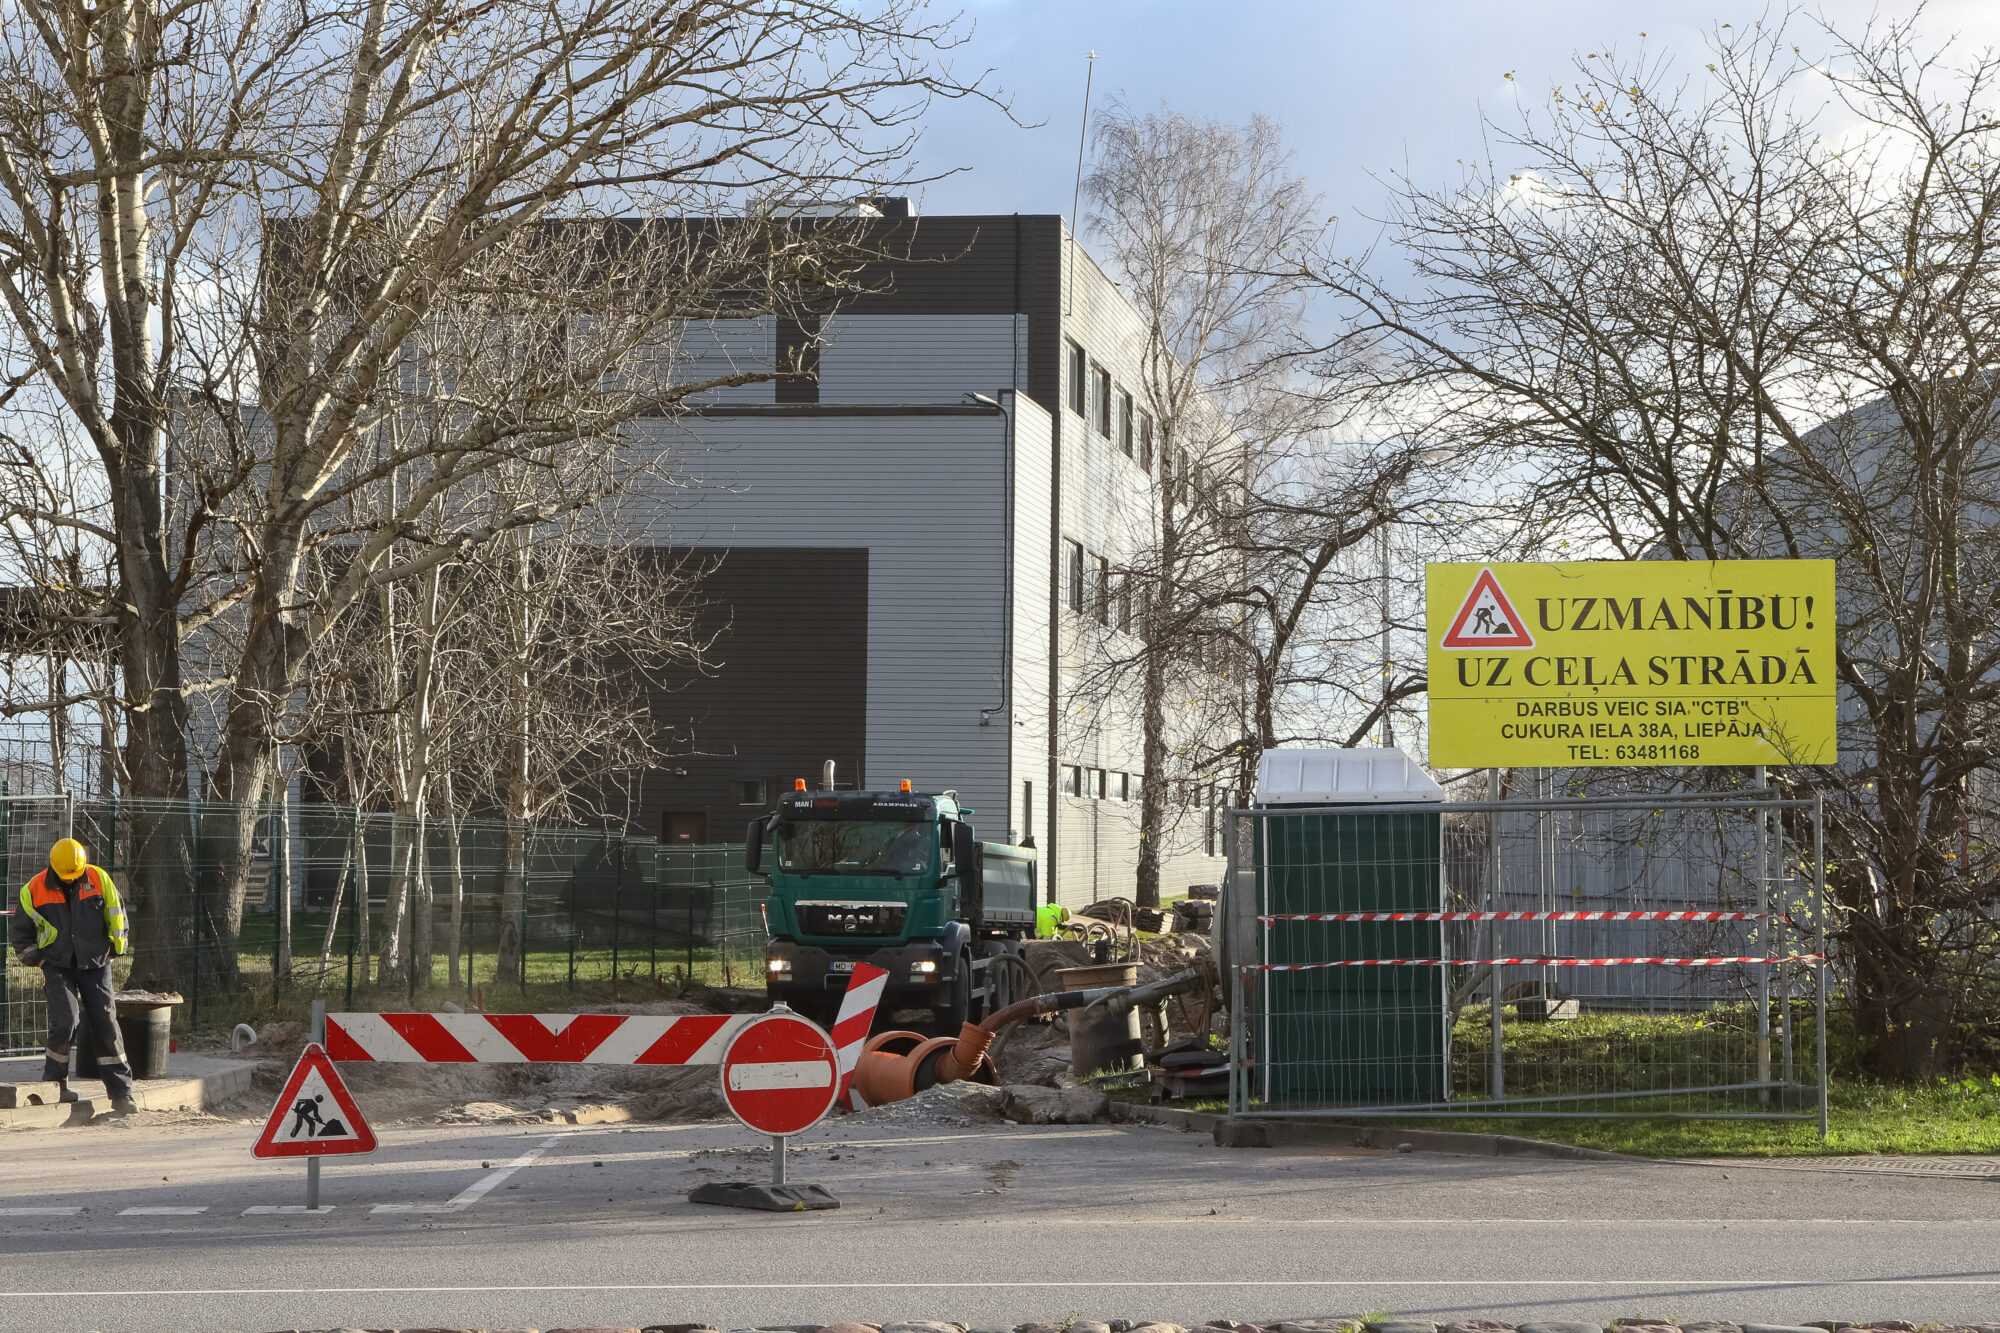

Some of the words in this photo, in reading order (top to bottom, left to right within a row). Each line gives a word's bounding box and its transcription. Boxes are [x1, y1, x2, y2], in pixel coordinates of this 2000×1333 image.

[1535, 589, 1815, 632] UZMANĪBU!
[1455, 656, 1513, 688] UZ
[1523, 655, 1639, 696] CEĻA
[1648, 648, 1818, 686] STRĀDĀ
[1516, 701, 1599, 717] DARBUS
[1604, 701, 1649, 716] VEIC
[1692, 700, 1748, 716] "CTB"
[1500, 723, 1585, 739] CUKURA
[1590, 723, 1634, 738] IELA
[1638, 723, 1678, 741] 38A,
[1684, 719, 1766, 738] LIEPĀJA
[1567, 745, 1609, 760] TEL:
[1616, 744, 1700, 760] 63481168
[794, 800, 810, 808] MAN
[828, 914, 873, 924] MAN
